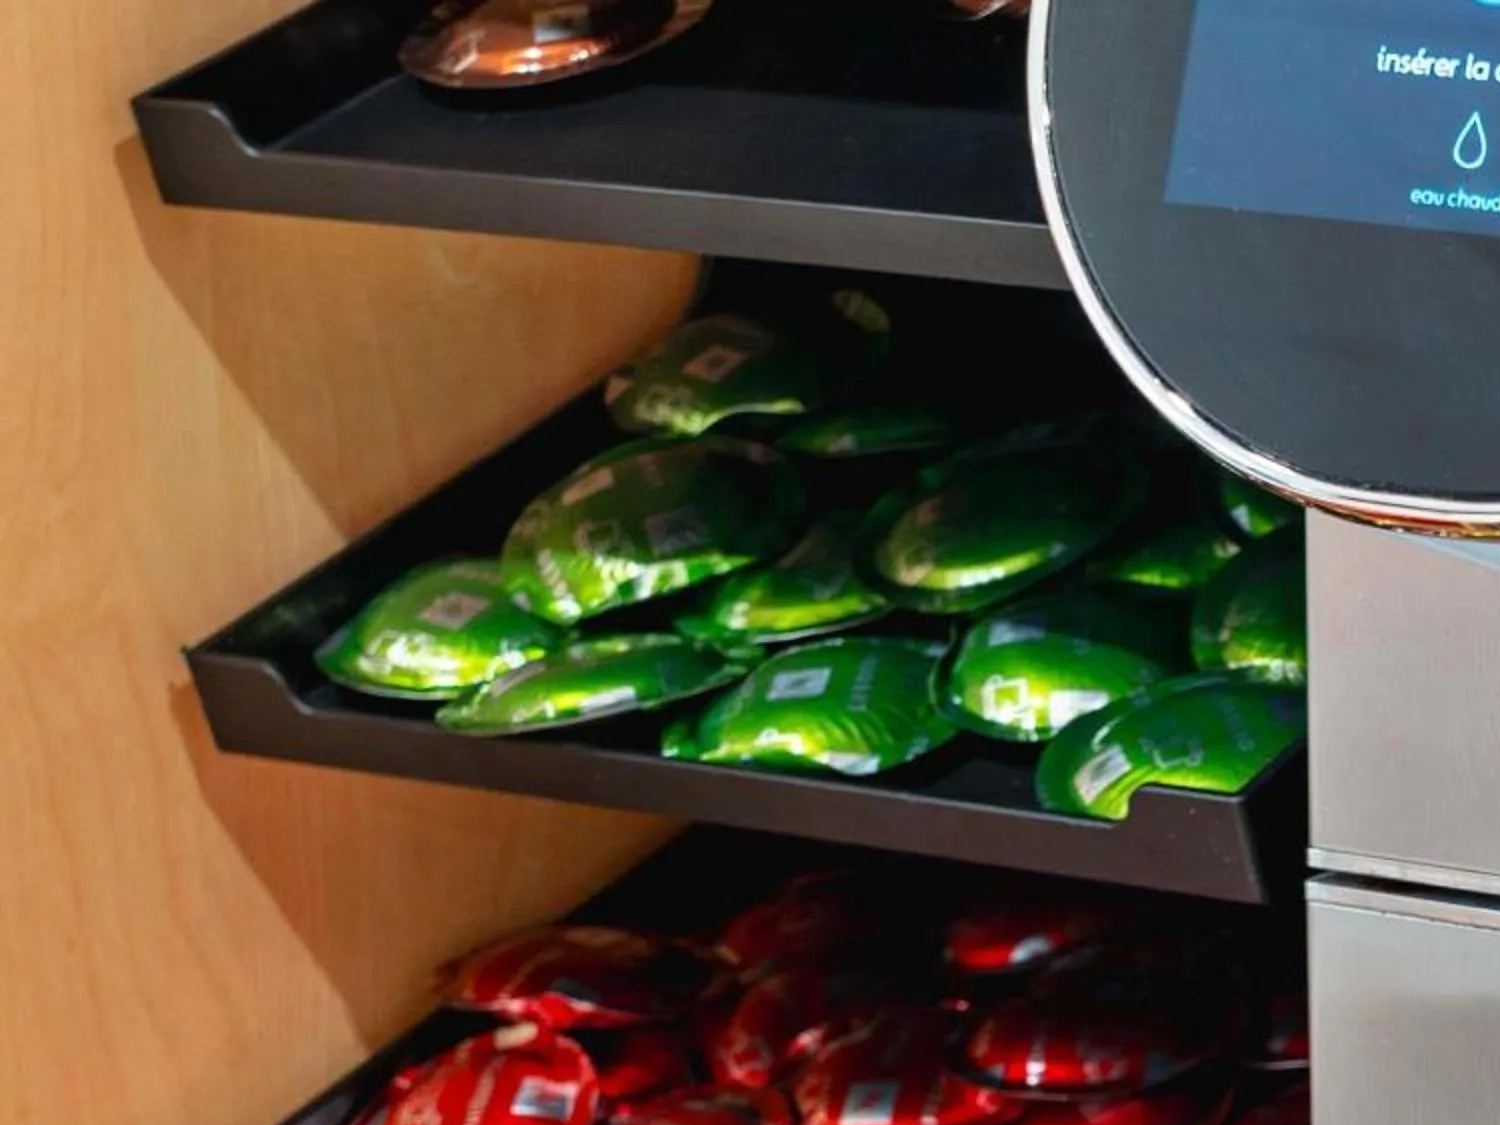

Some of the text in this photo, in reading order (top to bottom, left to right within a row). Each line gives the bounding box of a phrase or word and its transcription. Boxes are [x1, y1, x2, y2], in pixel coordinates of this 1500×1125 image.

[1376, 45, 1461, 79] insérer
[1464, 53, 1491, 82] la
[1409, 188, 1445, 207] eau
